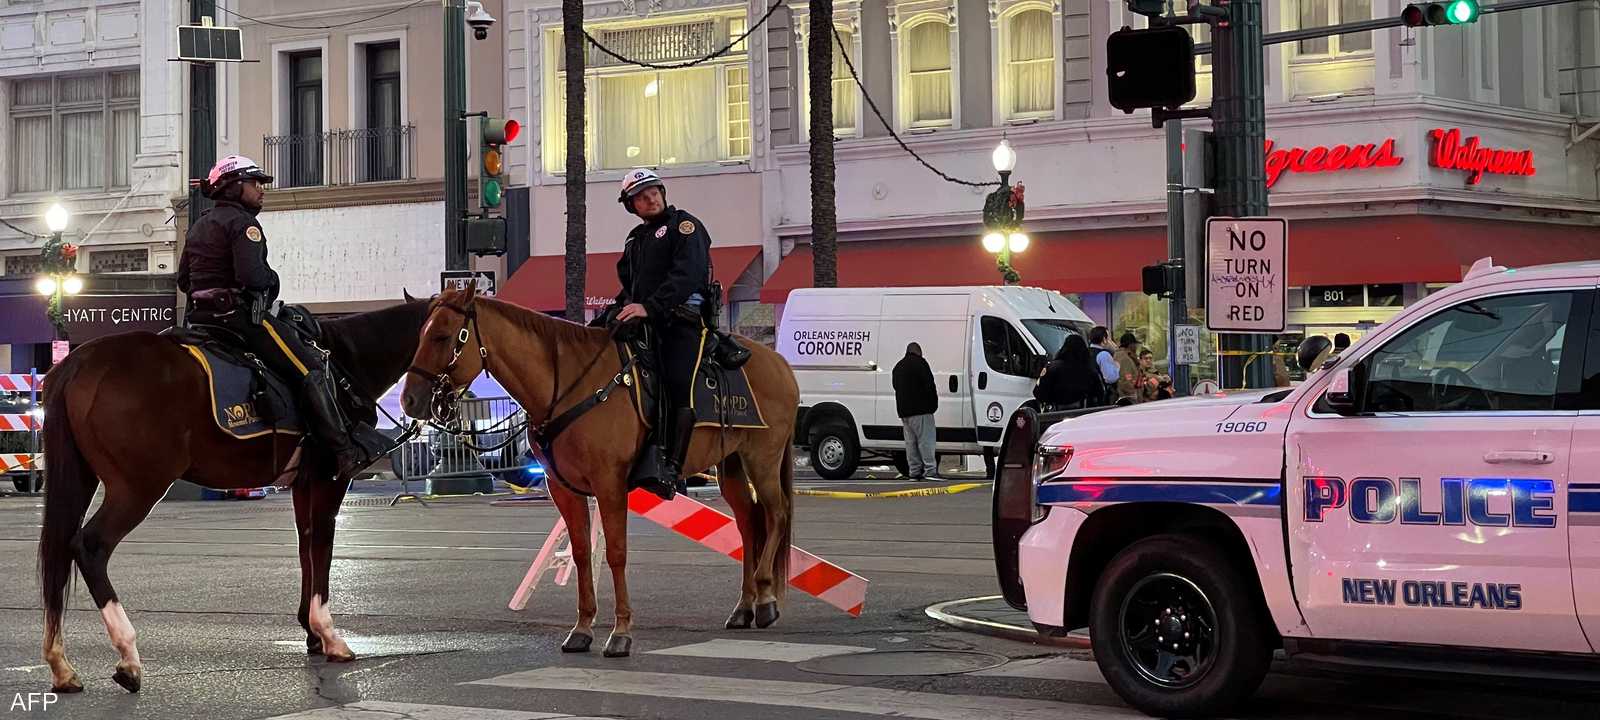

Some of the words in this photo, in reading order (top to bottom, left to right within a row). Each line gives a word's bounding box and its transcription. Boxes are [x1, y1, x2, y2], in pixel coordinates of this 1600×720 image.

[1264, 138, 1402, 187] greens
[1429, 127, 1535, 185] Walgreens
[1229, 229, 1266, 251] NO
[1224, 259, 1271, 274] TURN
[1235, 282, 1259, 298] ON
[1324, 290, 1344, 301] 801
[63, 308, 107, 322] HYATT
[111, 307, 172, 325] CENTRIC
[1230, 305, 1265, 321] RED
[793, 330, 836, 341] ORLEANS
[837, 331, 871, 342] PARISH
[797, 341, 863, 356] CORONER
[1215, 421, 1268, 433] 19060
[1302, 476, 1557, 529] POLICE
[1341, 577, 1397, 606] NEW
[1401, 580, 1522, 611] ORLEANS
